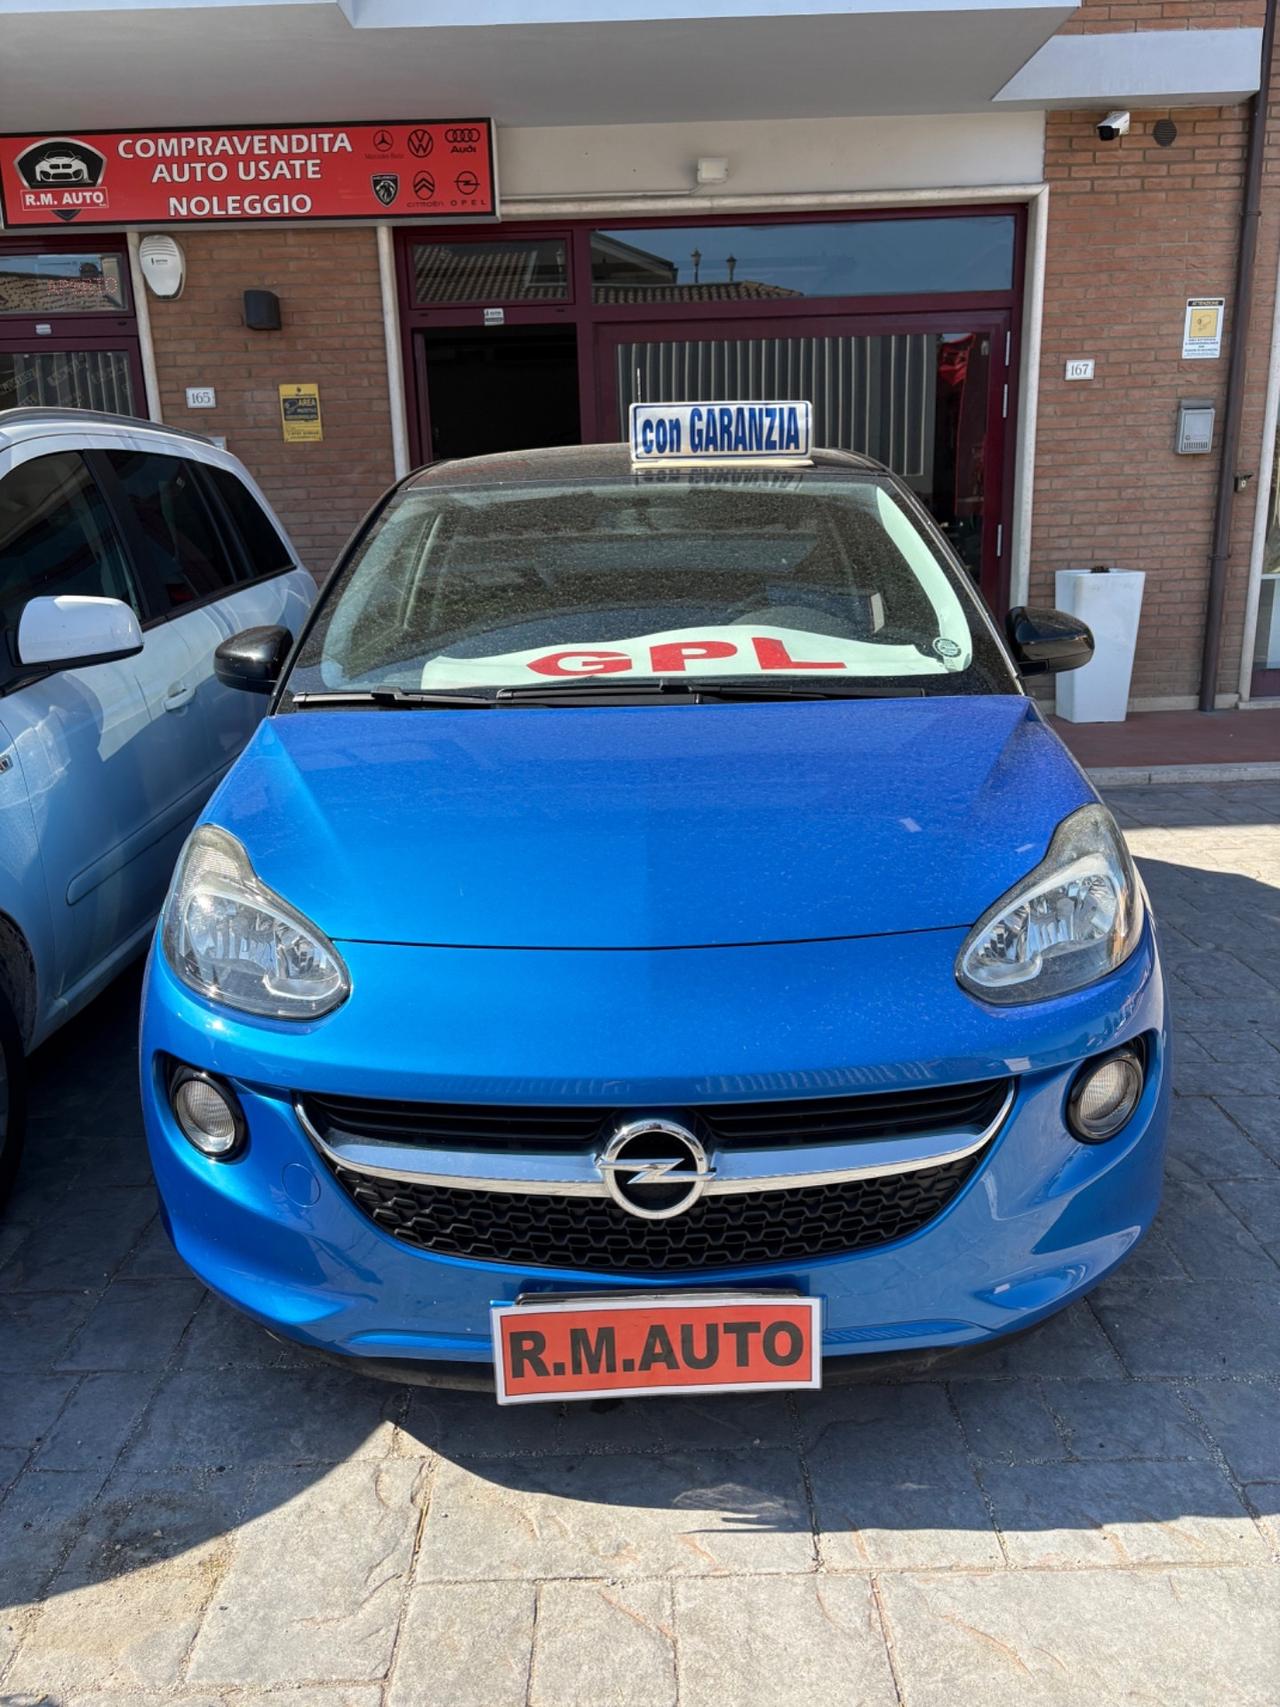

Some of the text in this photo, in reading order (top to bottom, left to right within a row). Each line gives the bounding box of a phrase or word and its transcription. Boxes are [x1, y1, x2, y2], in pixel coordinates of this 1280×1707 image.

[117, 132, 353, 159] COMPRAVENDITA
[450, 145, 477, 153] Audi
[152, 159, 322, 183] AUTO USATE
[25, 191, 104, 206] R.M. AUTO
[169, 193, 312, 216] NOLEGGIO
[1071, 363, 1089, 376] 167
[192, 391, 211, 404] 165
[642, 407, 800, 454] con GARANZIA
[526, 637, 848, 676] GPL
[508, 1320, 804, 1379] R.M.AUTO
